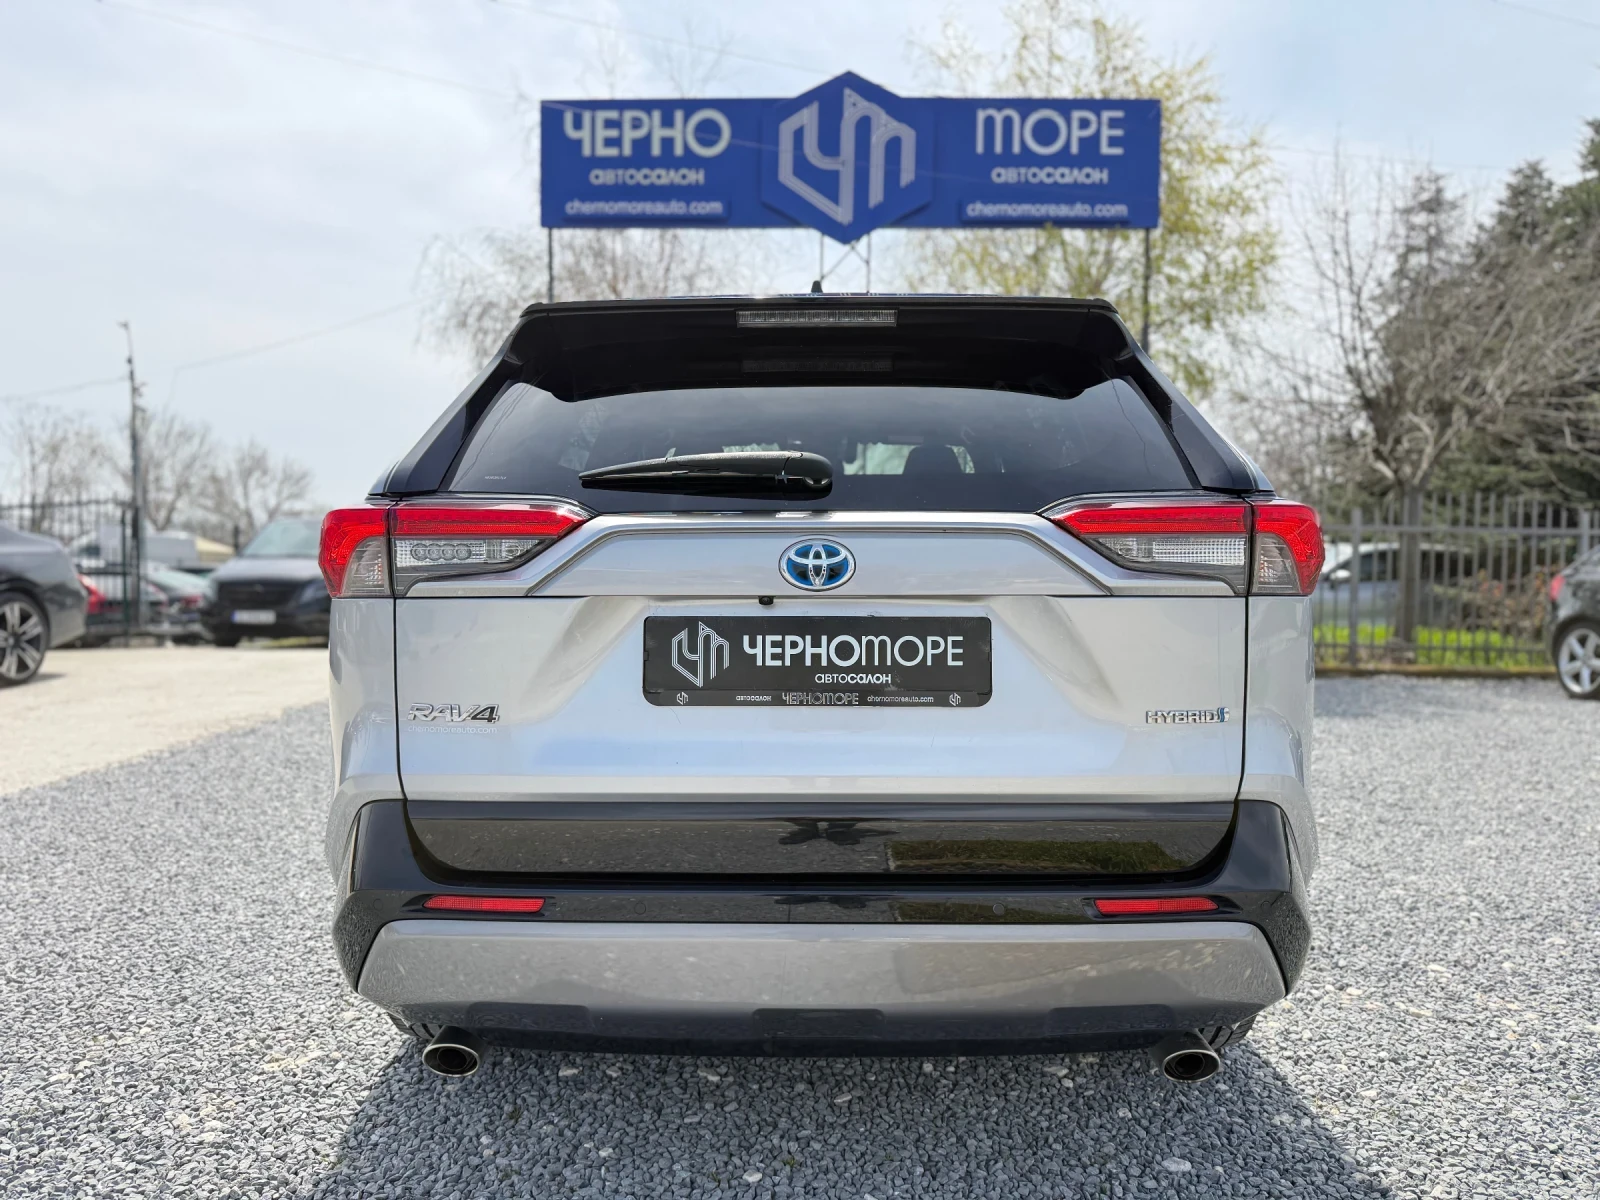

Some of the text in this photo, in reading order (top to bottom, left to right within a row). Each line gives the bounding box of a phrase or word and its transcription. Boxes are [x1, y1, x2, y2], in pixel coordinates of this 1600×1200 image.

[563, 108, 732, 158] ЧЕРНО
[815, 673, 892, 684] автосалон
[407, 703, 500, 724] RAV4
